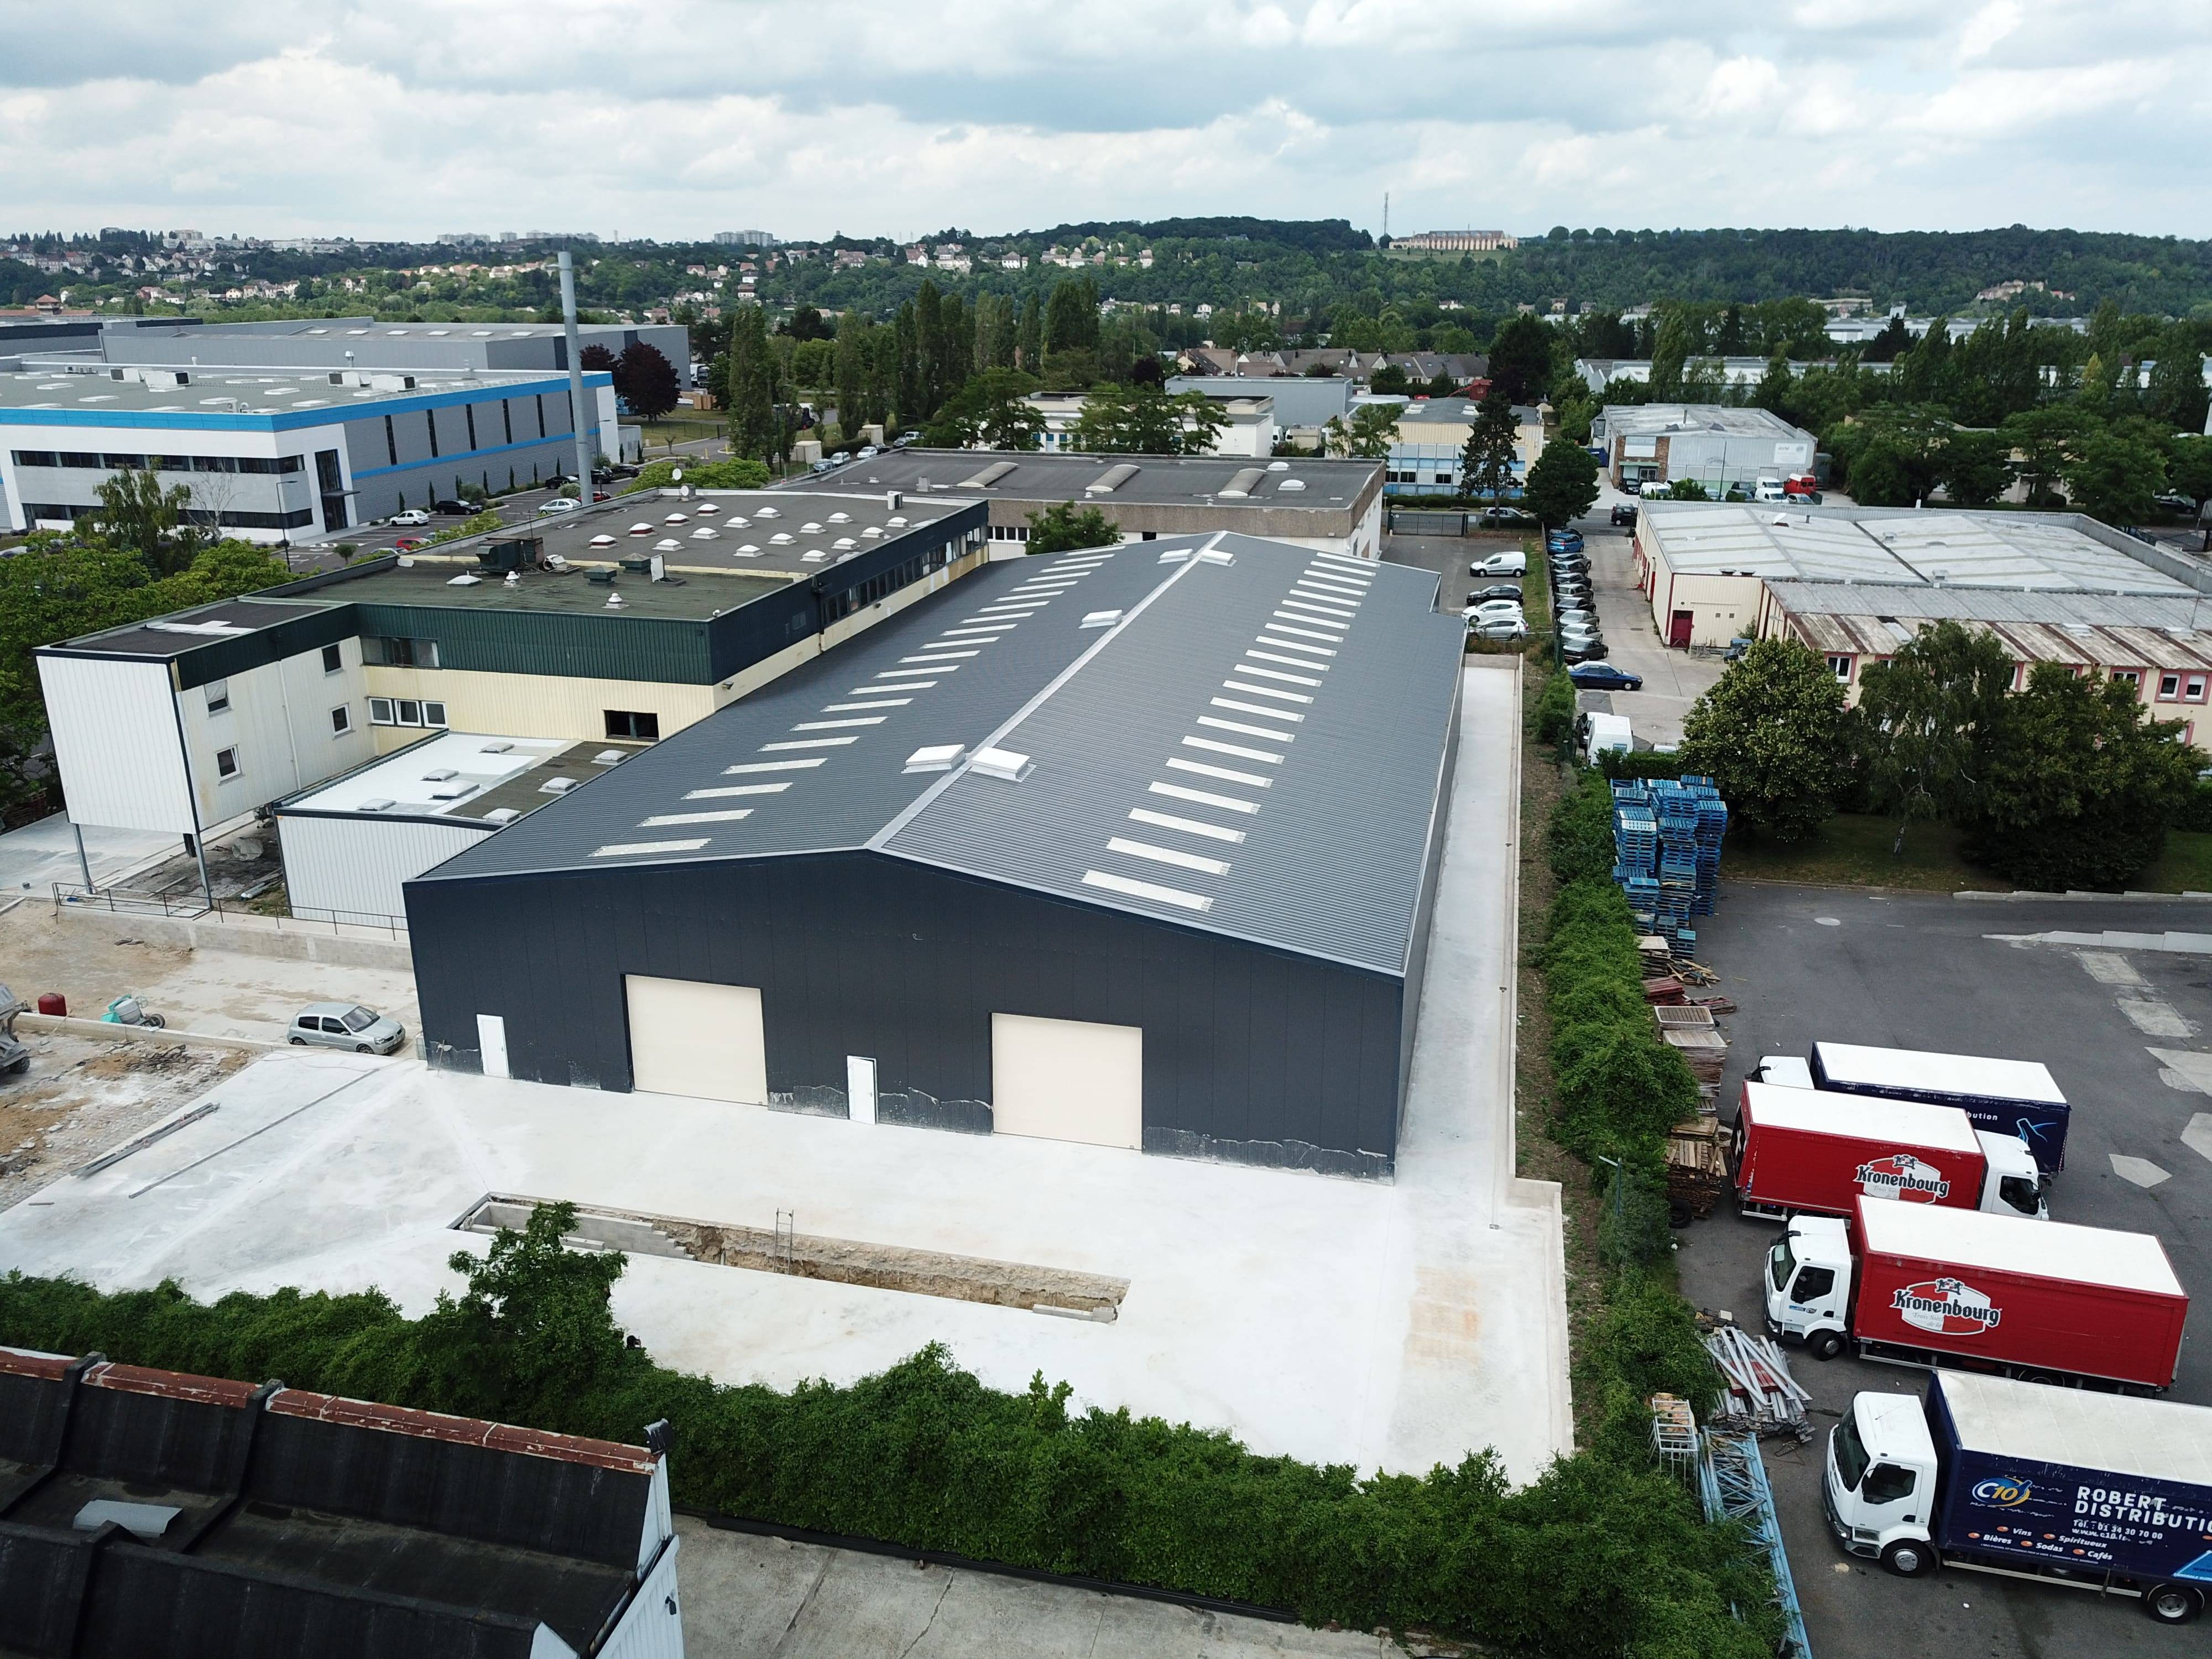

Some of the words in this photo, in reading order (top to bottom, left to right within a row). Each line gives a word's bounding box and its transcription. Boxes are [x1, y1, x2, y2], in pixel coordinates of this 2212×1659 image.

[1856, 1166, 1948, 1197] Kronenbourg
[1891, 1290, 1999, 1326] Kronenbourg
[1976, 1482, 2019, 1501] C10
[2077, 1486, 2167, 1511] ROBERT
[2013, 1527, 2032, 1536] Vins
[2111, 1525, 2122, 1533] 34
[1983, 1534, 2012, 1545] Bières
[2058, 1535, 2107, 1548] Spiritueux
[2036, 1542, 2064, 1552] Sodas
[2087, 1550, 2113, 1561] Cafés
